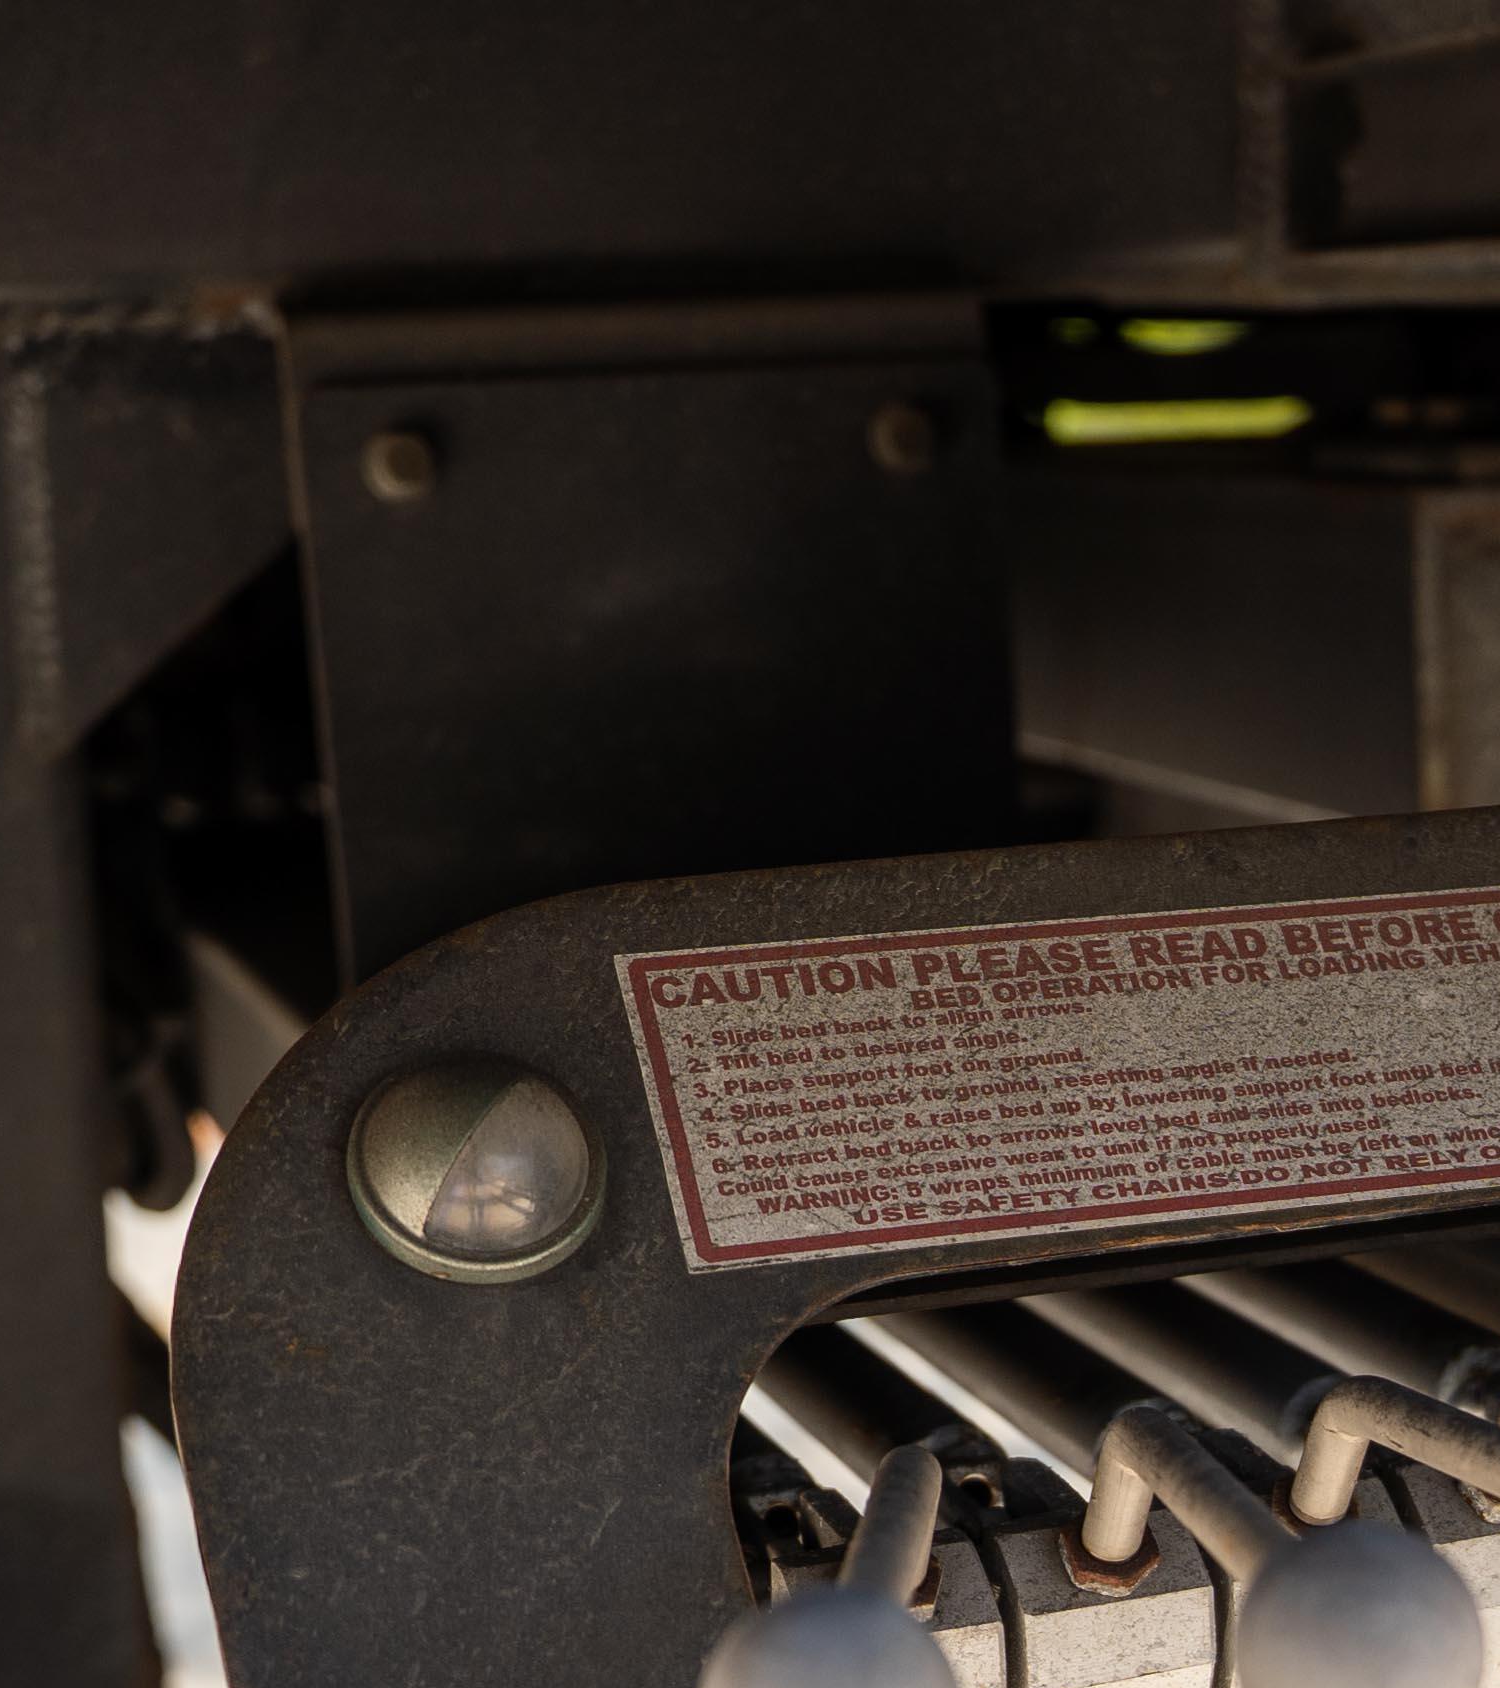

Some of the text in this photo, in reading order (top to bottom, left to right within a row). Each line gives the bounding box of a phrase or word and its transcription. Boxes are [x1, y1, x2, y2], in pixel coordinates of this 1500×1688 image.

[646, 956, 898, 1009] CAUTION
[909, 939, 1118, 987] PLEASE
[1126, 926, 1271, 969] READ
[1279, 909, 1481, 956] BEFORE
[909, 985, 984, 1011] BED
[990, 967, 1194, 1004] OPERATION
[1198, 961, 1271, 986] FOR
[1275, 948, 1427, 980] LOADING
[680, 1002, 1093, 1049] 1. Slide bed back to align arrows.
[715, 1052, 760, 1071] Tilt
[765, 1048, 814, 1066] bed
[818, 1045, 847, 1062] to
[852, 1036, 947, 1058] desired
[951, 1029, 1029, 1053] angle.
[691, 1048, 1093, 1098] 3. Place support foot on ground.
[697, 1106, 722, 1123] 4.
[728, 1100, 794, 1120] Slide
[798, 1095, 847, 1113] bed
[851, 1088, 914, 1108] back
[918, 1086, 946, 1102] to
[1051, 1065, 1166, 1093] resetting
[1168, 1059, 1238, 1082] angle
[1263, 1047, 1358, 1069] needed.
[703, 1131, 729, 1148] 5.
[734, 1124, 800, 1145] Load
[804, 1115, 895, 1138] vehicle
[901, 1113, 922, 1129] &
[928, 1106, 993, 1126] raise
[997, 1101, 1046, 1120] bed
[1050, 1100, 1084, 1118] up
[1086, 1094, 1119, 1115] by
[1121, 1084, 1229, 1111] lowering
[1230, 1074, 1325, 1101] support
[1326, 1069, 1378, 1088] foot
[1380, 1064, 1435, 1083] until
[1438, 1059, 1483, 1077] bed
[710, 1083, 1483, 1173] 6. Retract bed back to arrows level bed and slide into bedlocks.
[716, 1175, 789, 1196] Could
[794, 1170, 870, 1188] cause
[874, 1154, 998, 1180] excessive
[1003, 1150, 1066, 1167] wear
[1070, 1144, 1097, 1160] to
[1102, 1139, 1150, 1157] unit
[1154, 1137, 1174, 1152] if
[1176, 1132, 1218, 1149] not
[1221, 1122, 1321, 1148] properly
[755, 1185, 899, 1214] WARNING:
[903, 1182, 923, 1199] 5
[928, 1176, 1013, 1200] wraps
[1016, 1160, 1137, 1187] minimum
[1141, 1157, 1169, 1174] of
[1174, 1149, 1246, 1171] cable
[1250, 1142, 1317, 1163] must
[1319, 1139, 1352, 1156] be
[1356, 1133, 1403, 1152] left
[852, 1203, 929, 1226] USE
[938, 1187, 1083, 1217] SAFETY
[1299, 1157, 1375, 1179] NOT
[1383, 1147, 1474, 1170] RELY
